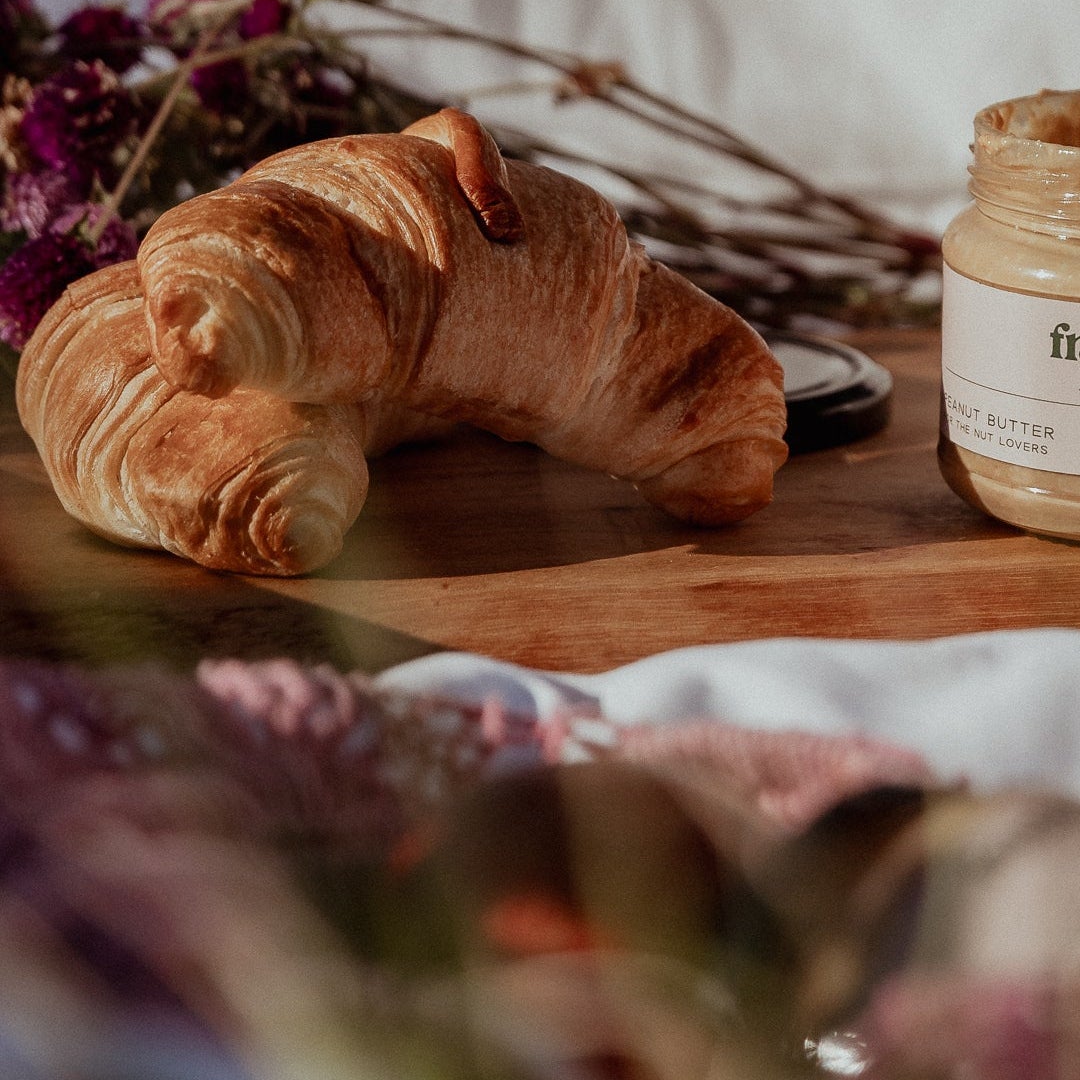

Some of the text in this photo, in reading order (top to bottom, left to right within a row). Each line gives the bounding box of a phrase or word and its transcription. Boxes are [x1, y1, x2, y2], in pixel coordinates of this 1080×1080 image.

[956, 419, 970, 434] THE
[974, 428, 993, 442] NUT
[999, 436, 1048, 455] LOVERS
[987, 413, 1054, 440] BUTTER
